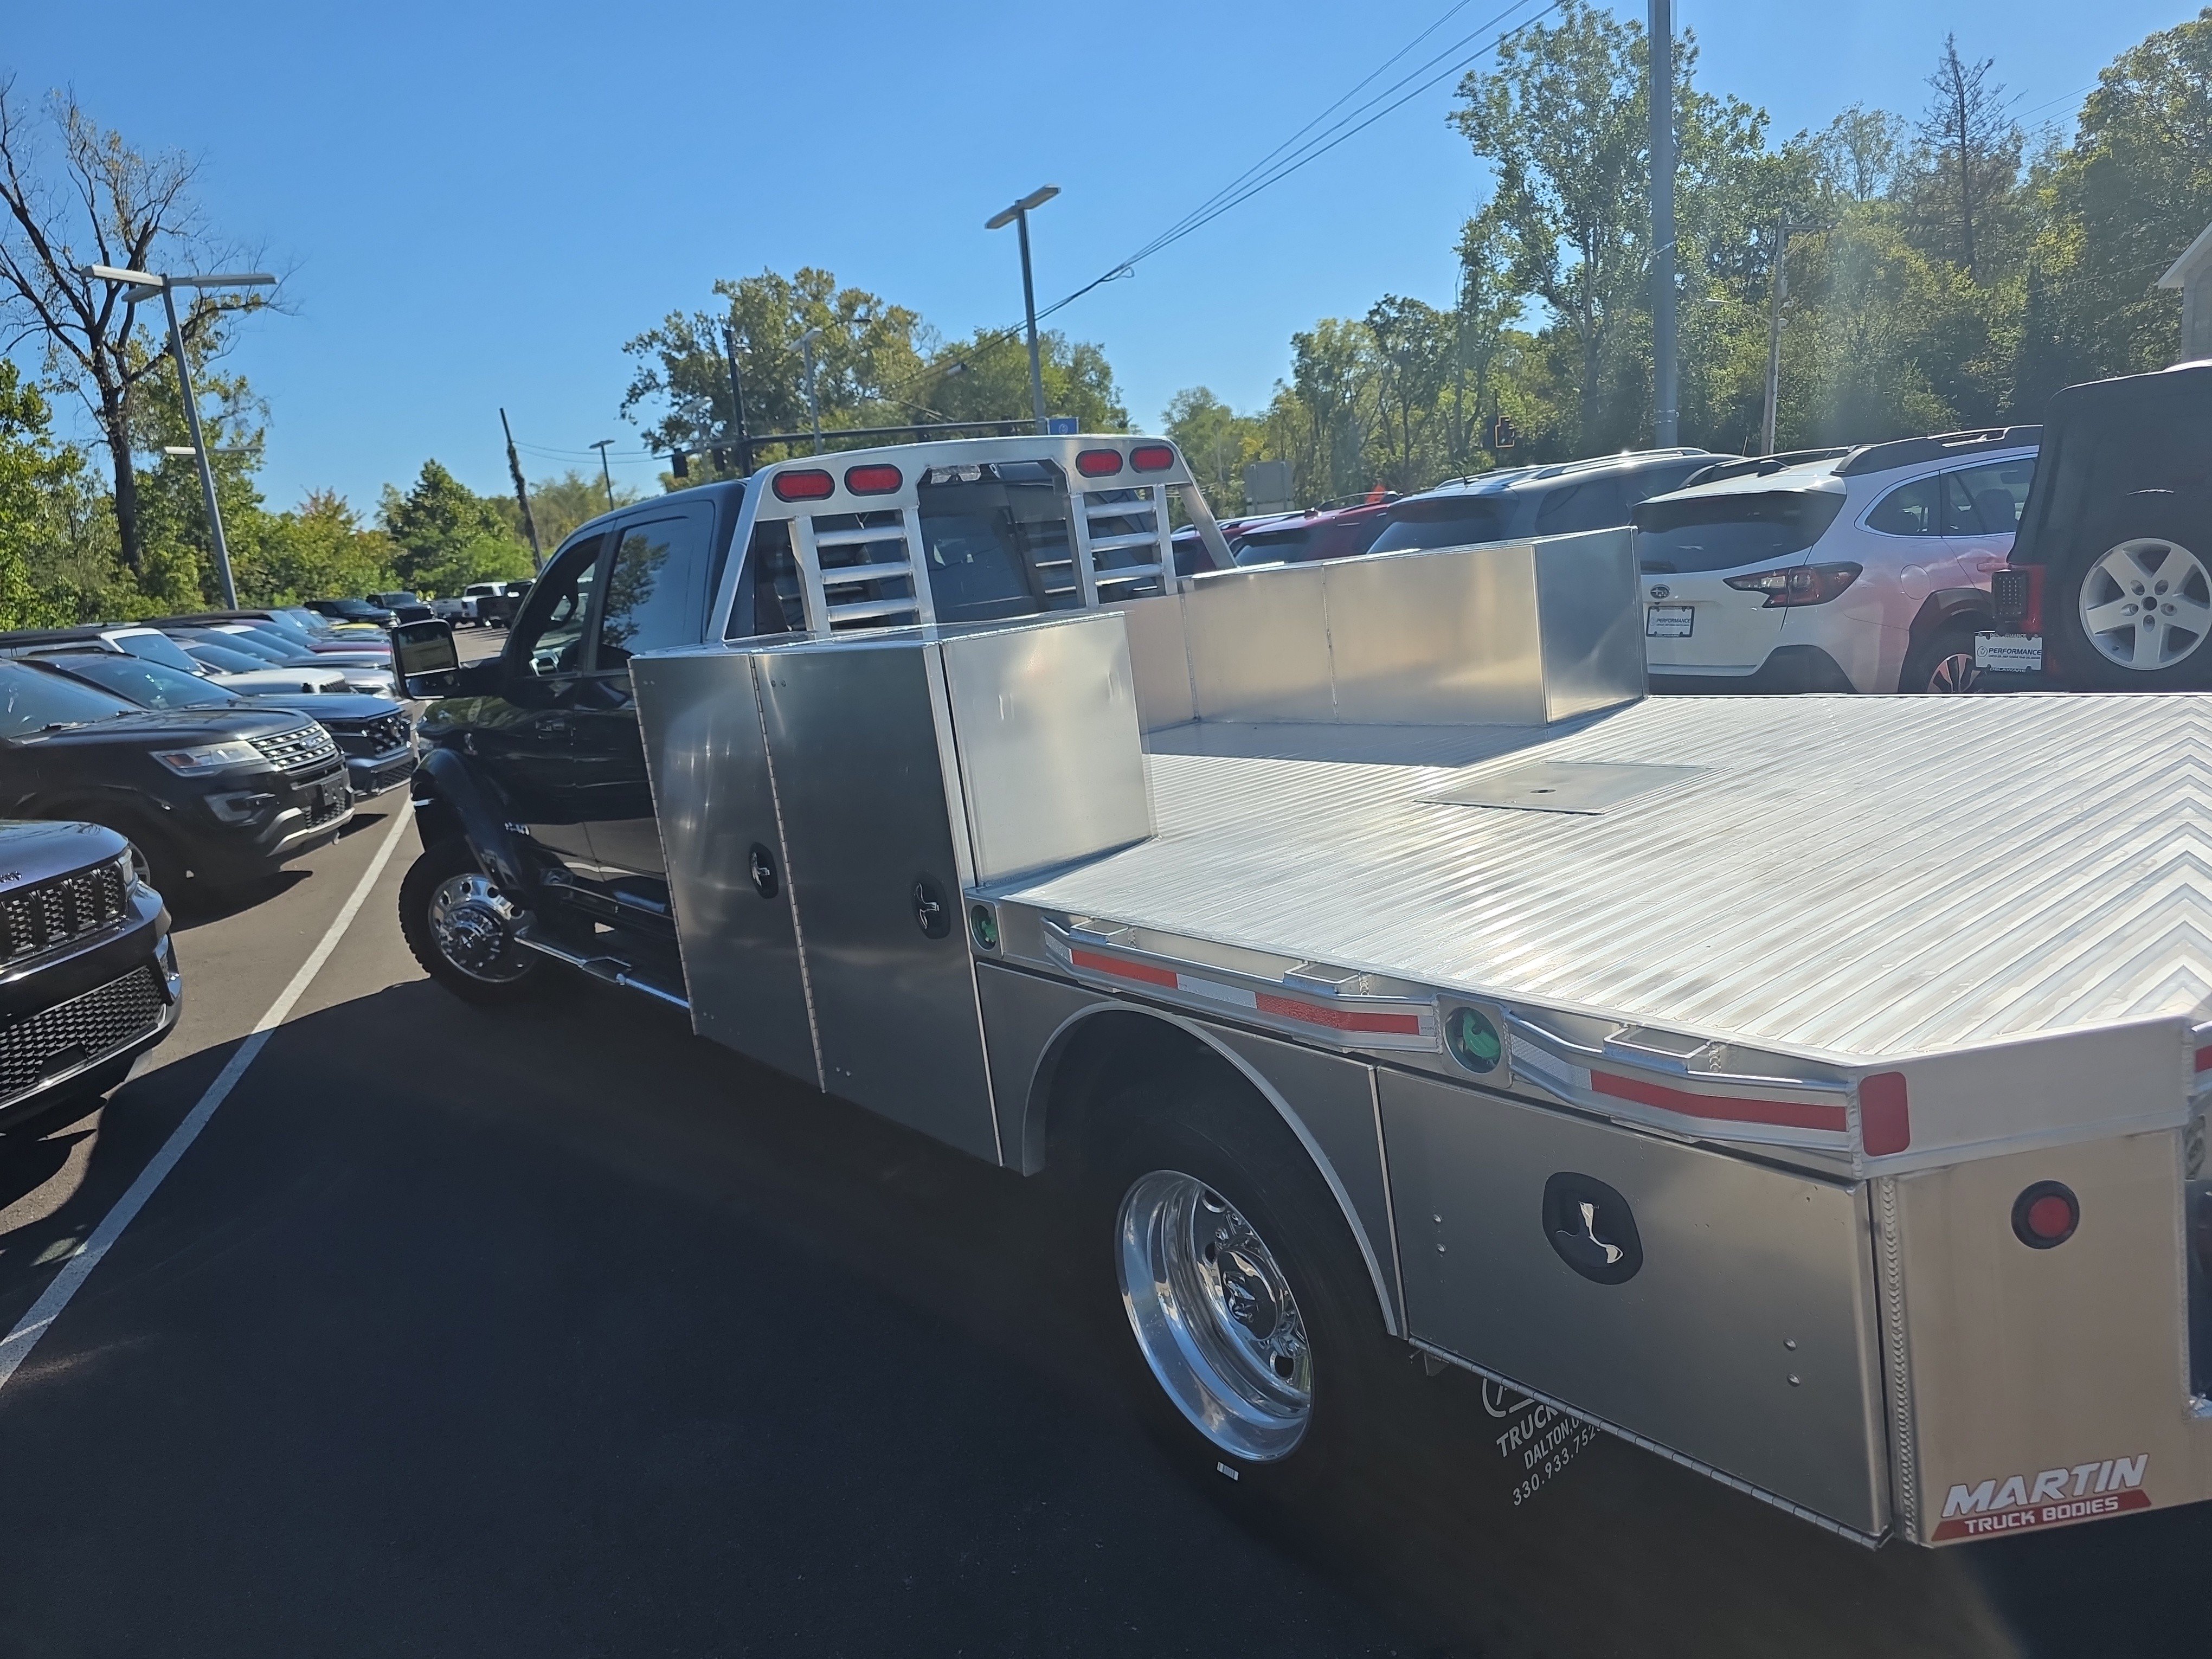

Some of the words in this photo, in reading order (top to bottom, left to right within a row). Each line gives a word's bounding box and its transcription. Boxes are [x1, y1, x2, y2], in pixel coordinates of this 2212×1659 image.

[1513, 1425, 1601, 1506] 330.933.752
[1941, 1454, 2149, 1518] MARTIN
[1965, 1510, 2035, 1534] TRUCK
[2042, 1496, 2119, 1522] BODIES
